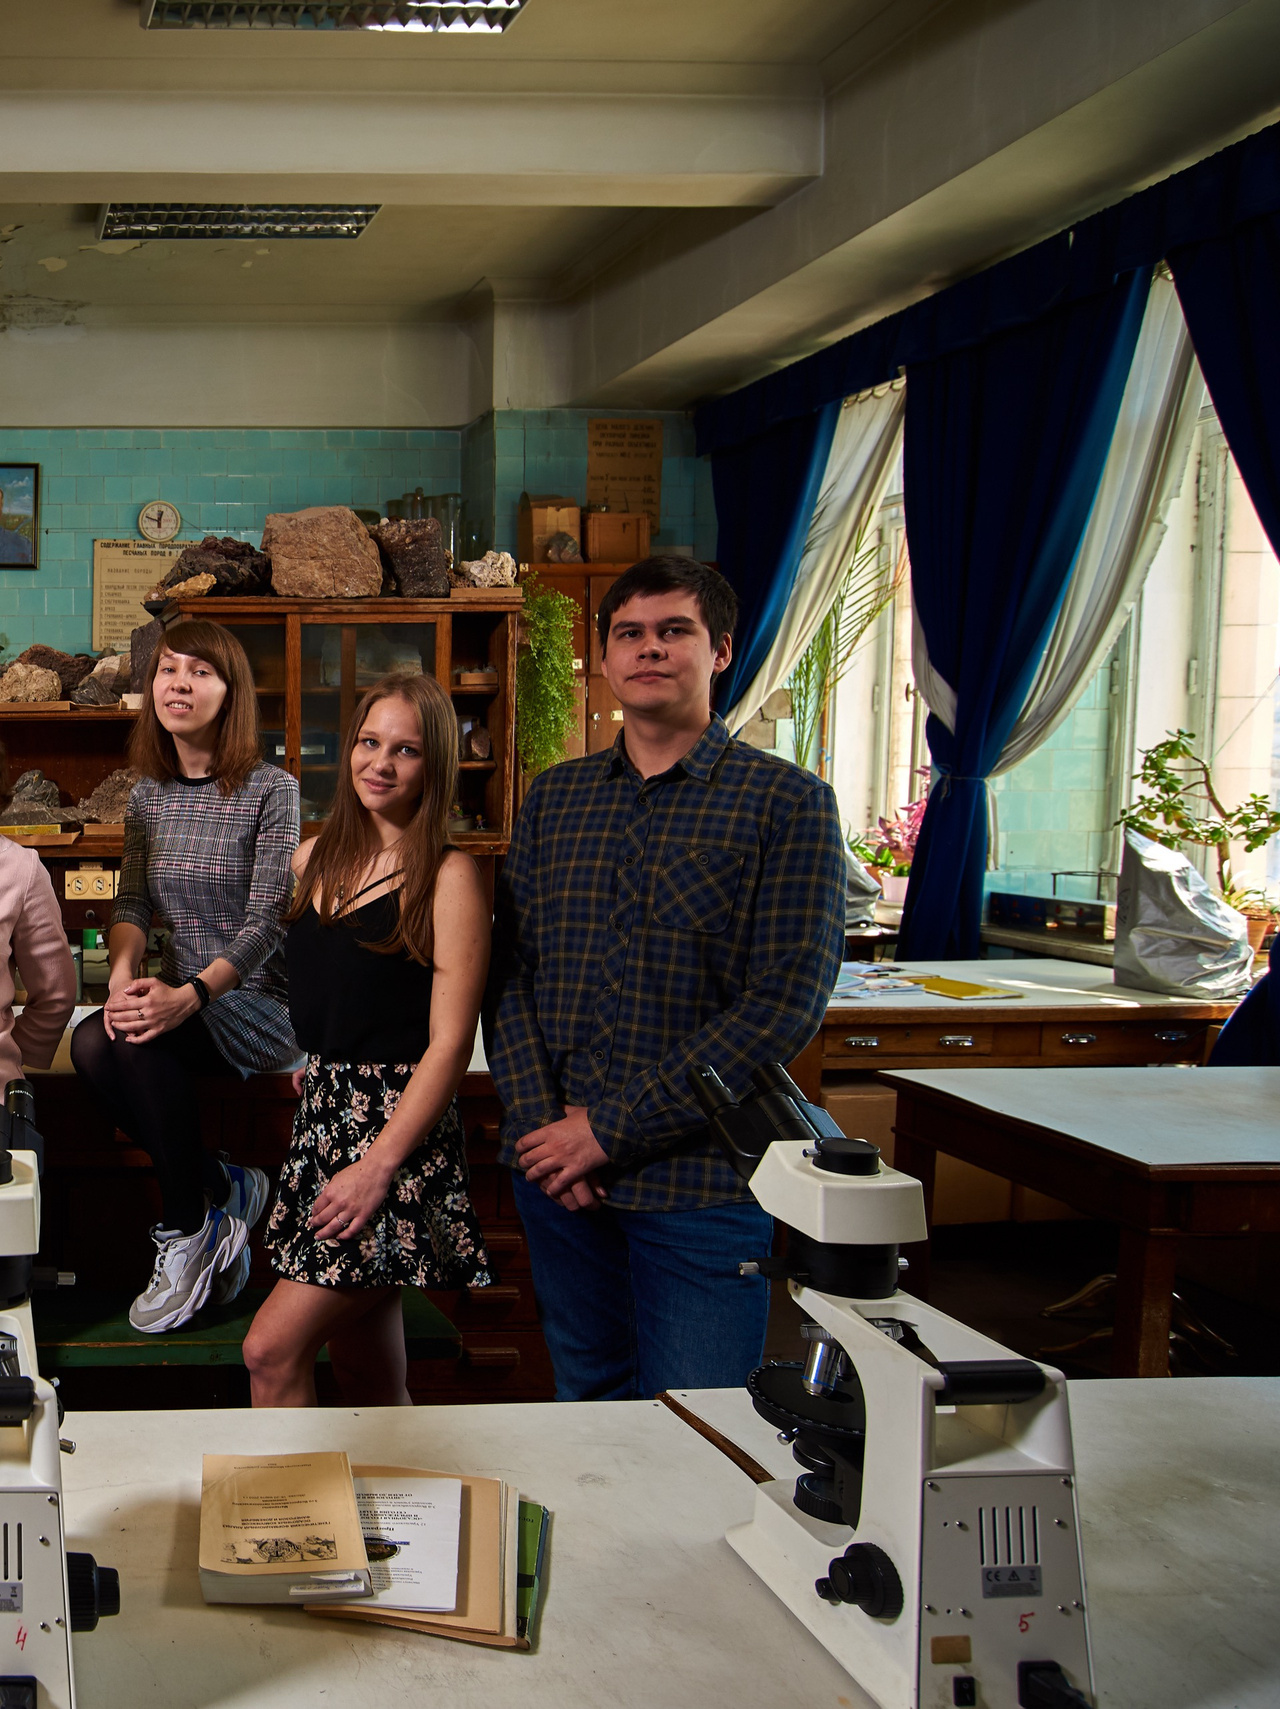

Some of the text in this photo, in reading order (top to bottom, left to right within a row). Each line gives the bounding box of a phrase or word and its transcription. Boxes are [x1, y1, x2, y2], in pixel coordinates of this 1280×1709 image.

[522, 563, 527, 571] 3
[1018, 1611, 1035, 1633] 5
[16, 1626, 27, 1651] 4
